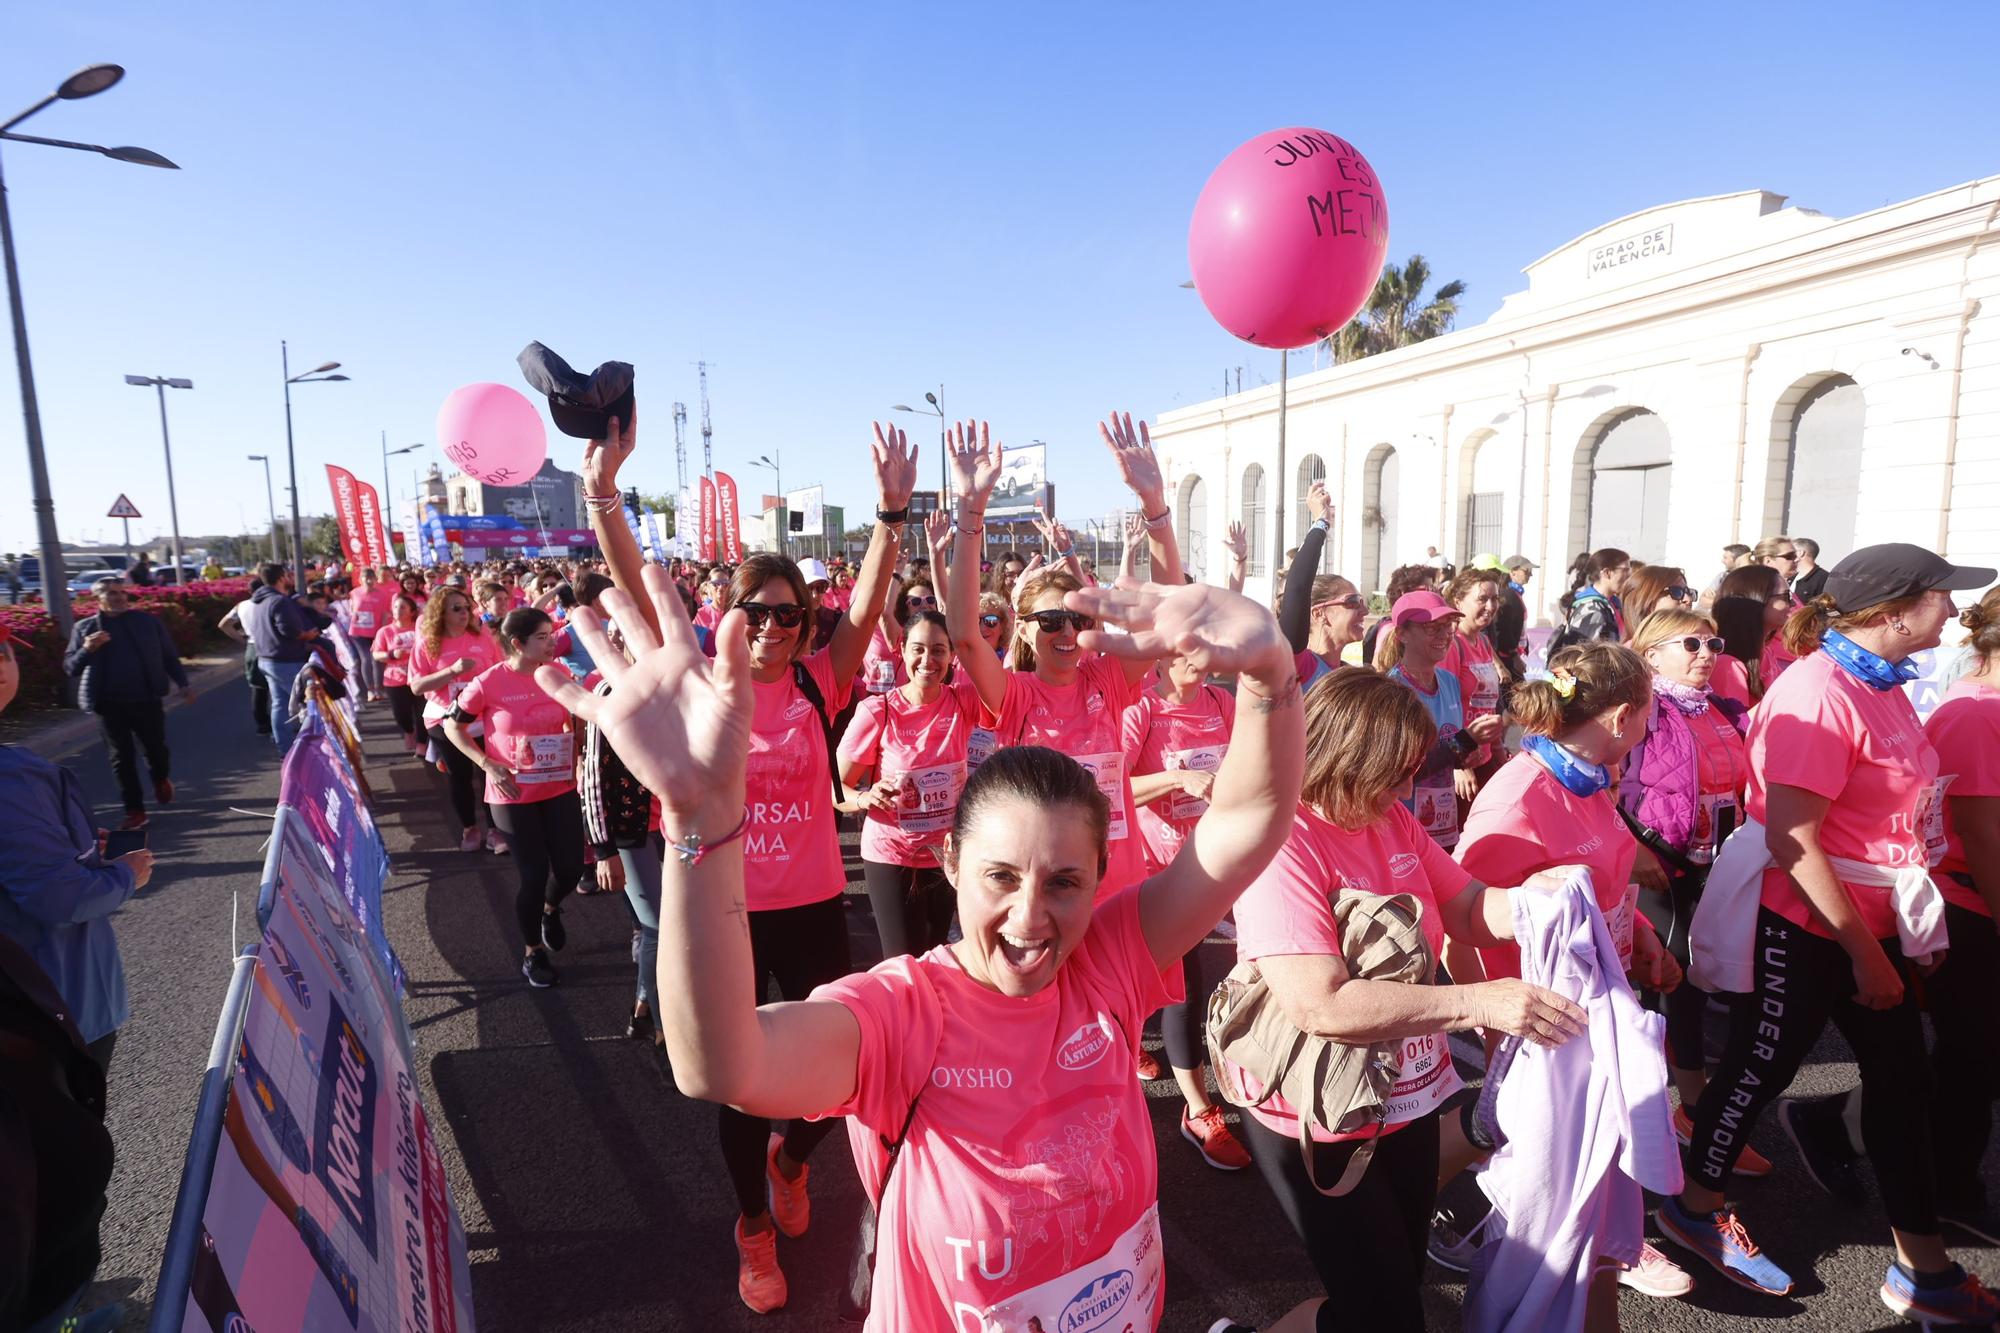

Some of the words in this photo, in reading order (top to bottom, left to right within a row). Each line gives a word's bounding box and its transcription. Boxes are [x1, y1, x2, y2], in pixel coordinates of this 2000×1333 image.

[1336, 158, 1371, 188] ES
[1643, 230, 1664, 245] DE
[1592, 243, 1666, 272] VALENCIA
[923, 790, 948, 803] 016
[1751, 946, 1788, 1062] UNDER
[1406, 1033, 1433, 1060] 016
[931, 1066, 1013, 1089] OYSHO
[1417, 1080, 1424, 1088] DE
[327, 1020, 367, 1225] Norauto
[1702, 1067, 1762, 1179] ARMOUR
[405, 1198, 418, 1217] a
[945, 1236, 1013, 1281] TU
[1066, 1281, 1130, 1333] ASTURIANA
